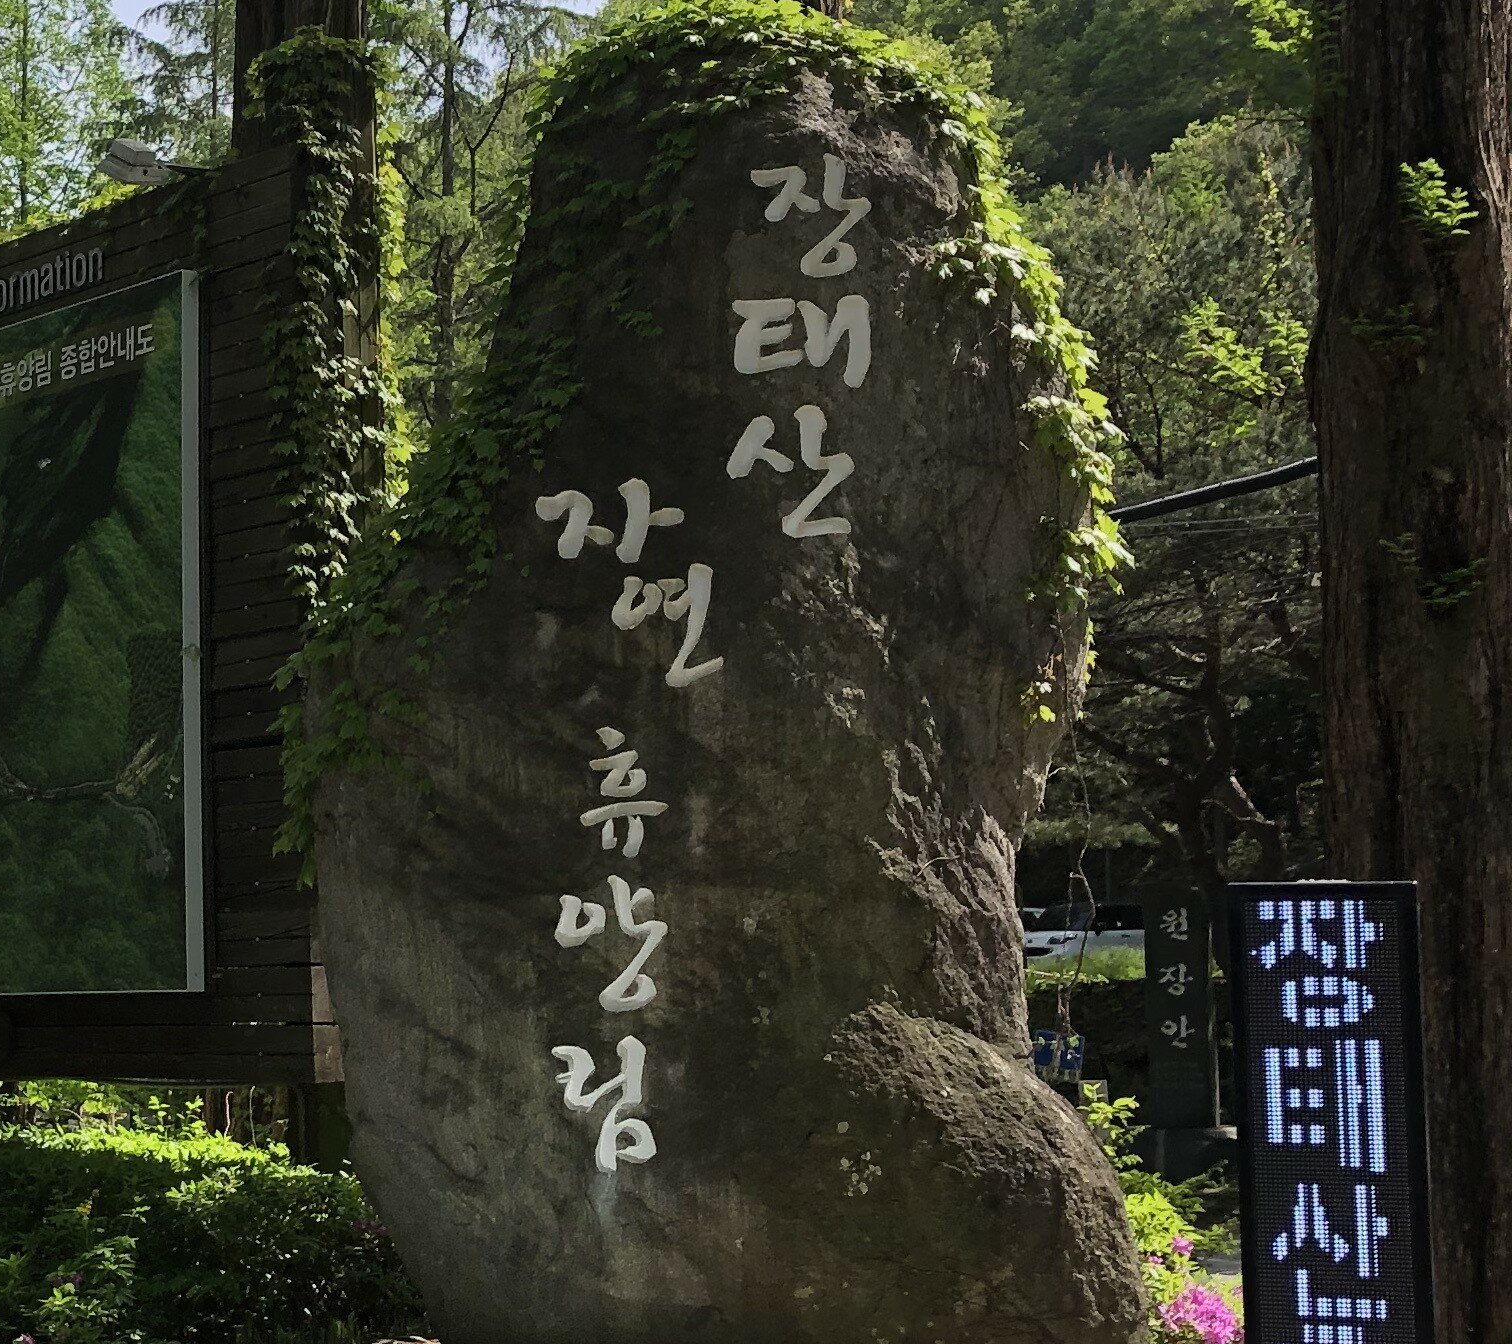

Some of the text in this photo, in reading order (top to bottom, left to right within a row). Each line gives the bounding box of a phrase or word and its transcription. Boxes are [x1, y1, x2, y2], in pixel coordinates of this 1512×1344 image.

[59, 323, 156, 381] 종합안내도
[725, 152, 874, 540] 장태산
[535, 477, 724, 688] 자연
[552, 725, 670, 1173] 휴양림
[1158, 907, 1196, 1050] 원장안
